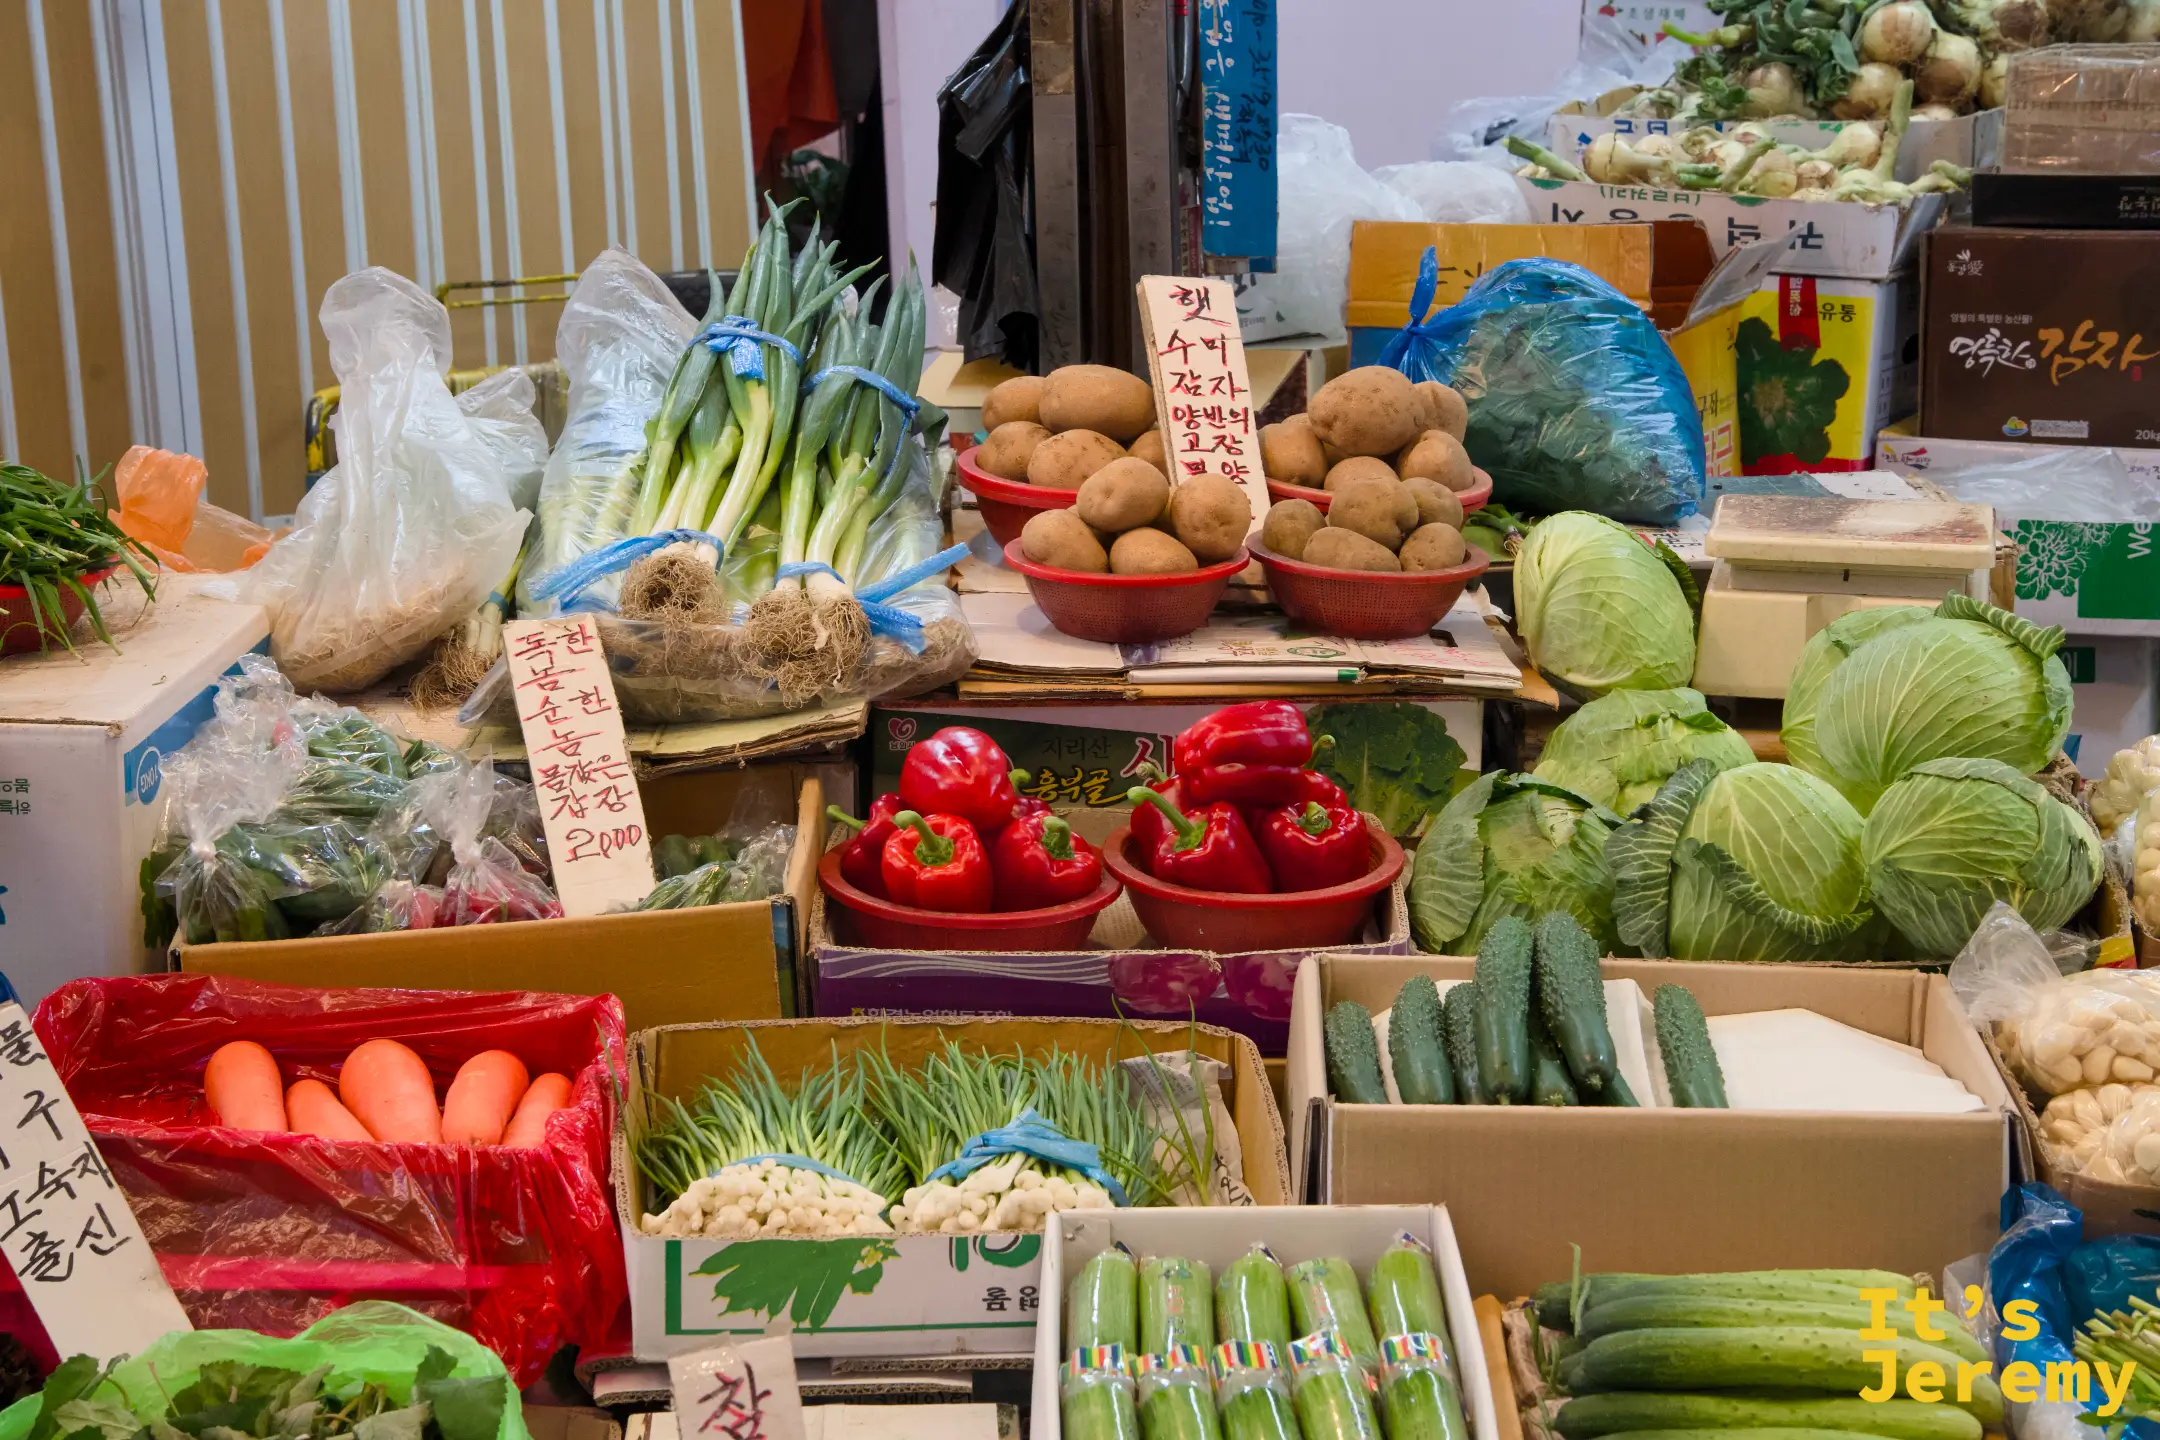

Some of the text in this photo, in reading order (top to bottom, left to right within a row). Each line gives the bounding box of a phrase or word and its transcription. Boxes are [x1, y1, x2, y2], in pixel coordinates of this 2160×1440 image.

[1172, 404, 1249, 434] 양반의
[1180, 432, 1245, 456] 고장
[1044, 736, 1112, 761] 지리산
